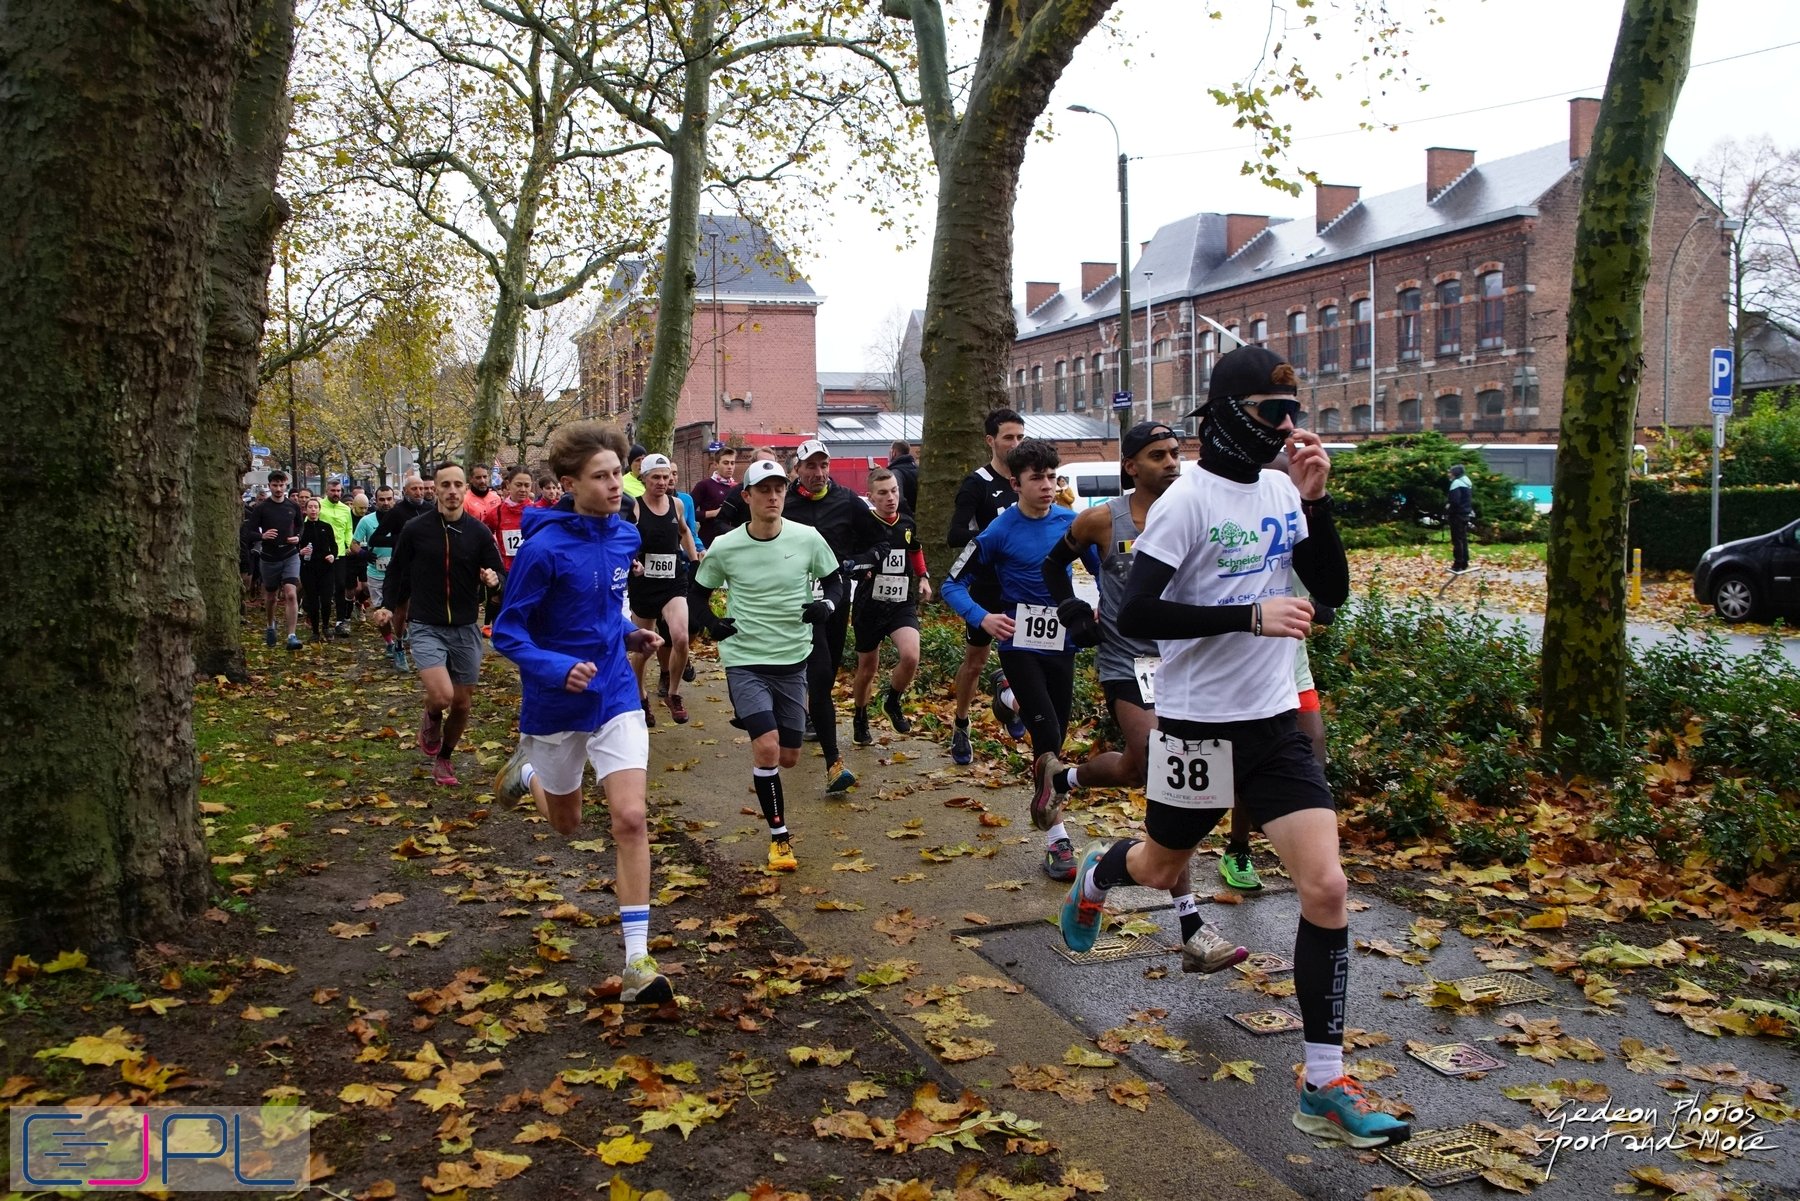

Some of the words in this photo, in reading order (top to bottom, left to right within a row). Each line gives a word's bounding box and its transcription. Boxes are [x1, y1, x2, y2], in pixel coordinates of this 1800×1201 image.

[1713, 357, 1730, 389] P
[650, 560, 673, 571] 7660
[879, 585, 903, 596] 1391
[1025, 616, 1059, 639] 199
[1167, 755, 1210, 792] 38
